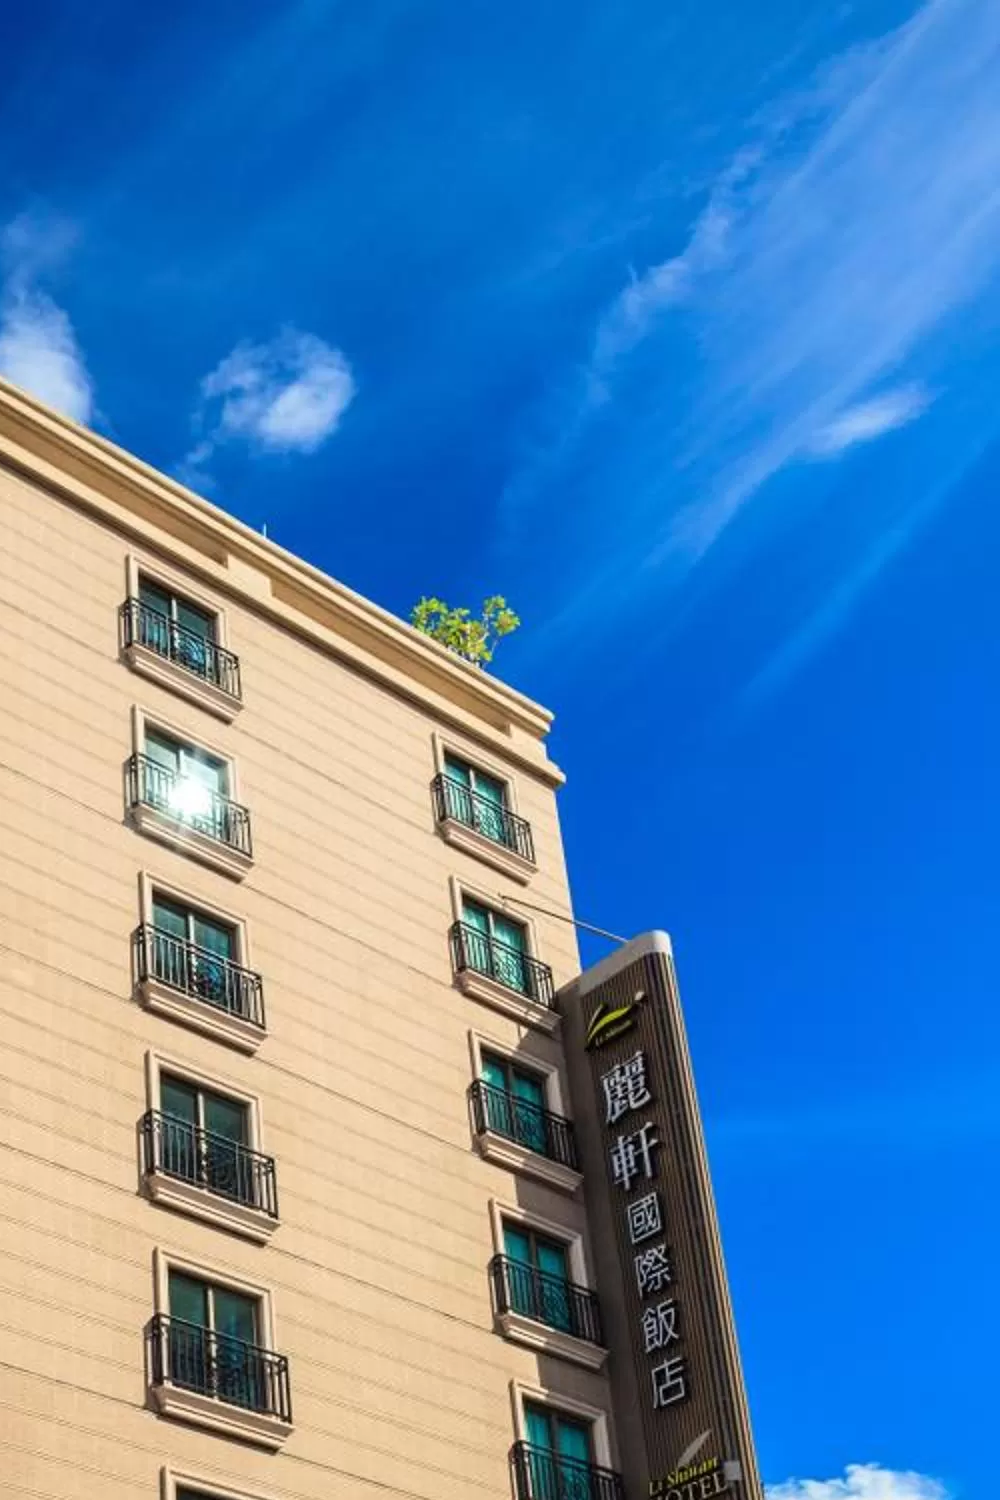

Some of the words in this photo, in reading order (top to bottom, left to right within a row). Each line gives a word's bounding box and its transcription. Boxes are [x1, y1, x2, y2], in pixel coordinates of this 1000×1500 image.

[601, 1050, 685, 1408] 麗軒國際飯店
